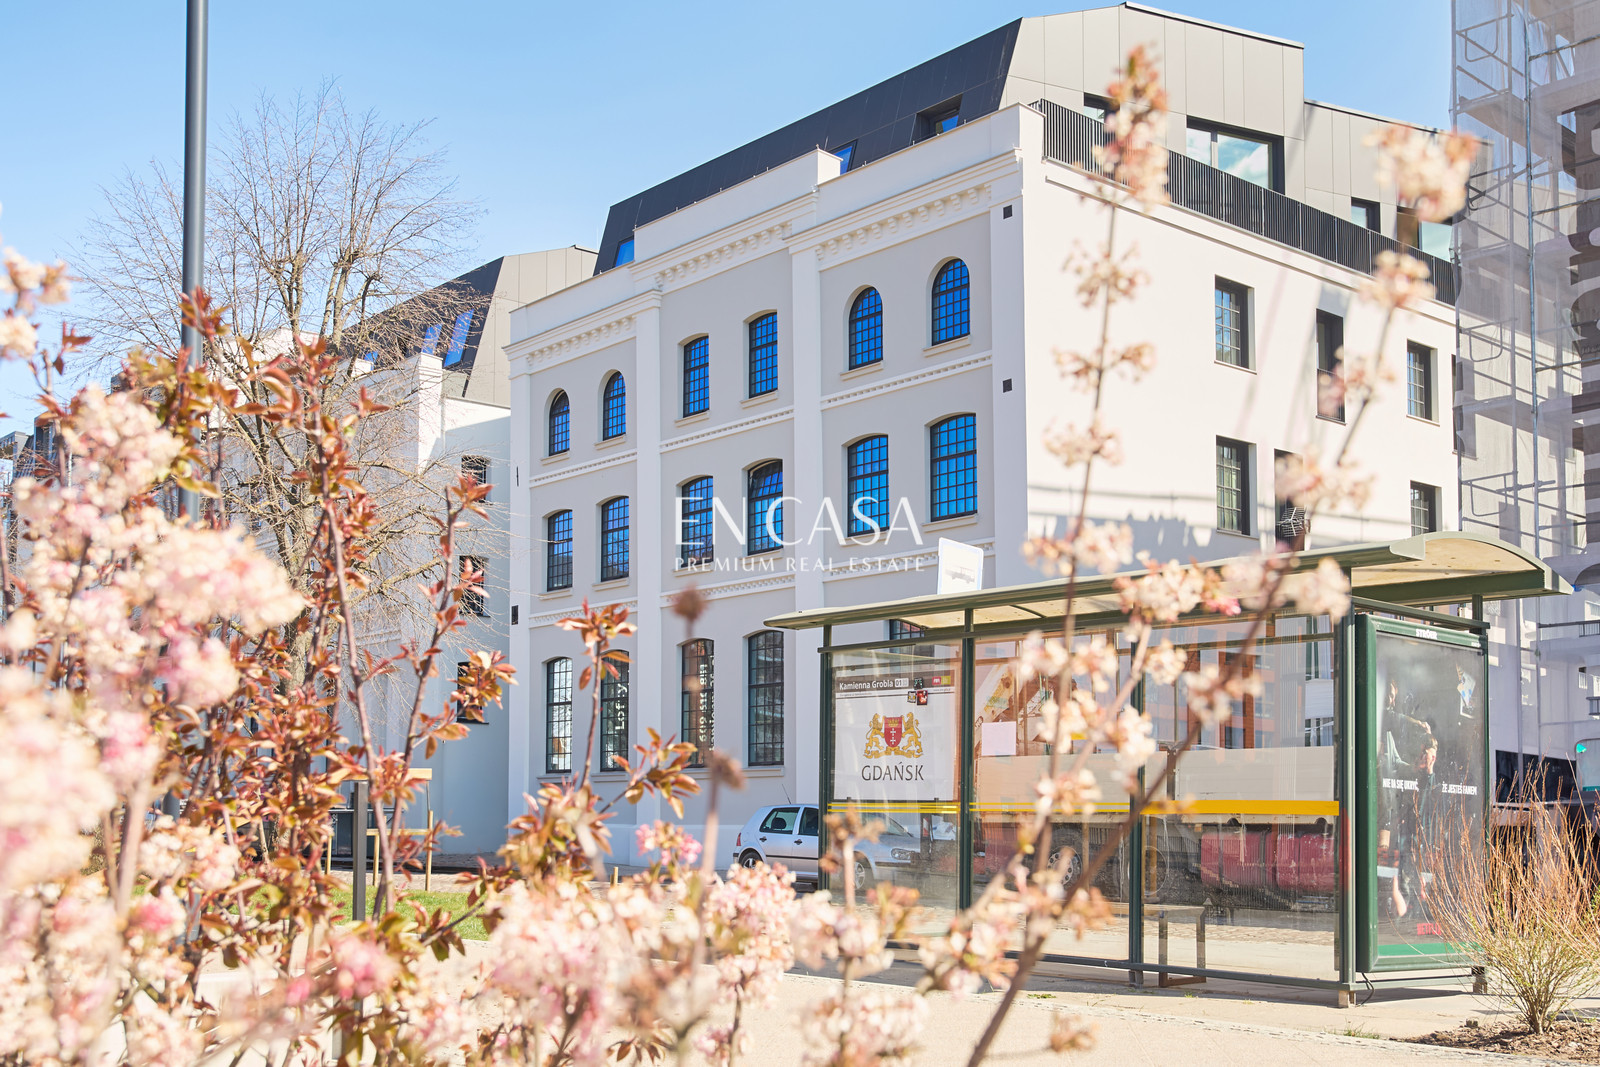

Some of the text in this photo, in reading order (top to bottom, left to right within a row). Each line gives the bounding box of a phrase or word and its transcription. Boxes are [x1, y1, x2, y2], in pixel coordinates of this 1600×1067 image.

[839, 681, 870, 690] Kamienna
[871, 679, 893, 688] Grobla
[861, 762, 924, 781] GDAŃSK
